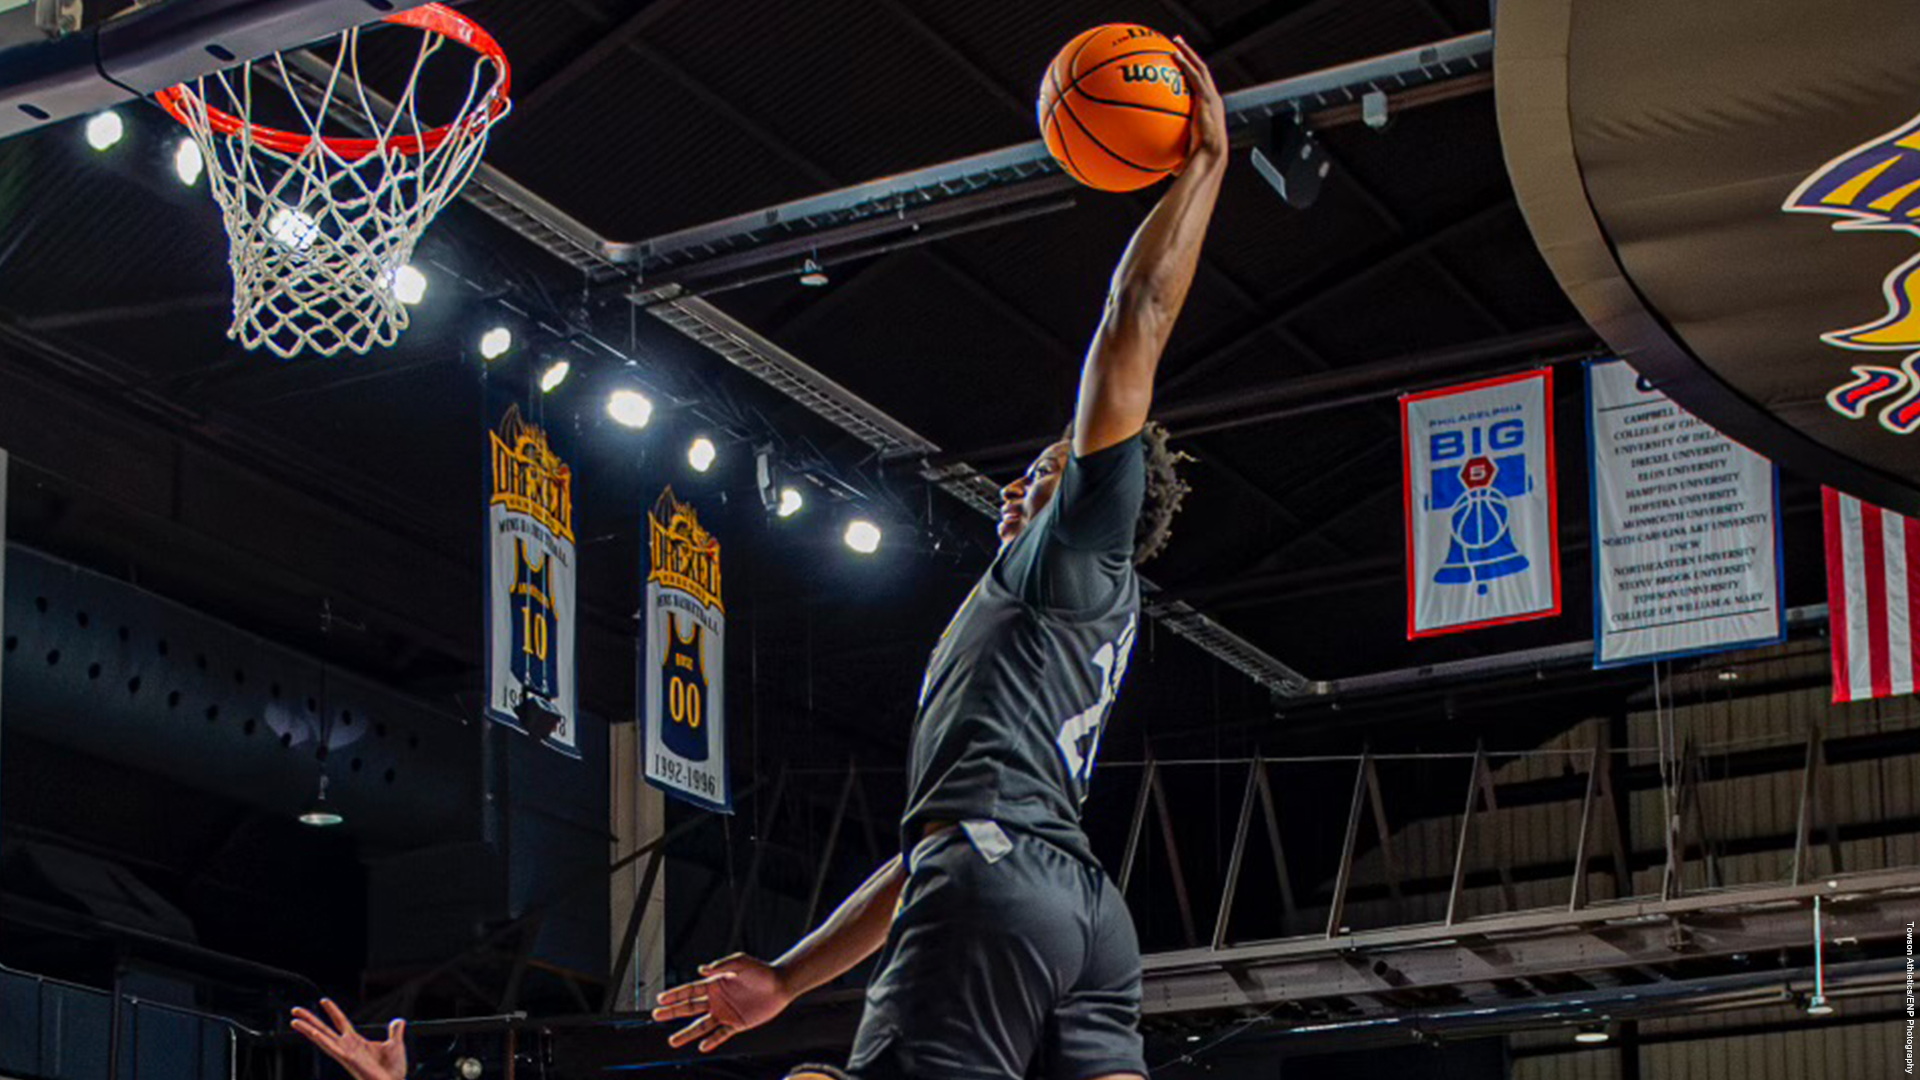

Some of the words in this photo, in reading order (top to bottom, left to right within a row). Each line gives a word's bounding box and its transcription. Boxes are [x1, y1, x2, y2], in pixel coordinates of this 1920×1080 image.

[1430, 404, 1522, 427] PHILADELPHIA
[1624, 407, 1675, 425] CAMPBELL
[1431, 419, 1524, 461] BIG
[1613, 426, 1660, 440] COLLEGE
[1662, 421, 1677, 432] OF
[1615, 438, 1674, 455] UNIVERSITY
[1676, 433, 1690, 444] OF
[1631, 454, 1670, 468] DREXEL
[1672, 443, 1732, 460] UNIVERSITY
[1469, 465, 1486, 481] 5
[1637, 470, 1665, 482] ELON
[1667, 459, 1728, 476] UNIVERSITY
[1625, 484, 1678, 499] HAMPTON
[1680, 472, 1740, 490] UNIVERSITY
[1629, 499, 1676, 514] HOFSTRA
[1678, 489, 1738, 506] UNIVERSITY
[1623, 511, 1684, 529] MONMOUTH
[1686, 502, 1745, 520] UNIVERSITY
[1602, 536, 1635, 547] NORTH
[1637, 528, 1686, 543] CAROLINA
[1712, 513, 1768, 530] UNIVERSITY
[1669, 541, 1700, 552] UNCW
[1613, 557, 1696, 576] NORTHEASTERN
[1698, 546, 1757, 564] UNIVERSITY
[1618, 578, 1653, 591] STONY
[1655, 572, 1692, 585] BROOK
[1694, 563, 1753, 580] UNIVERSITY
[1634, 590, 1678, 604] TOWSON
[1680, 580, 1740, 596] UNIVERSITY
[1611, 607, 1656, 622] COLLEGE
[1659, 605, 1673, 616] OF
[1676, 600, 1719, 613] WILLIAM
[1734, 593, 1764, 605] MARY
[522, 606, 548, 661] 10
[670, 676, 701, 727] 00
[655, 754, 716, 796] 1992-1996
